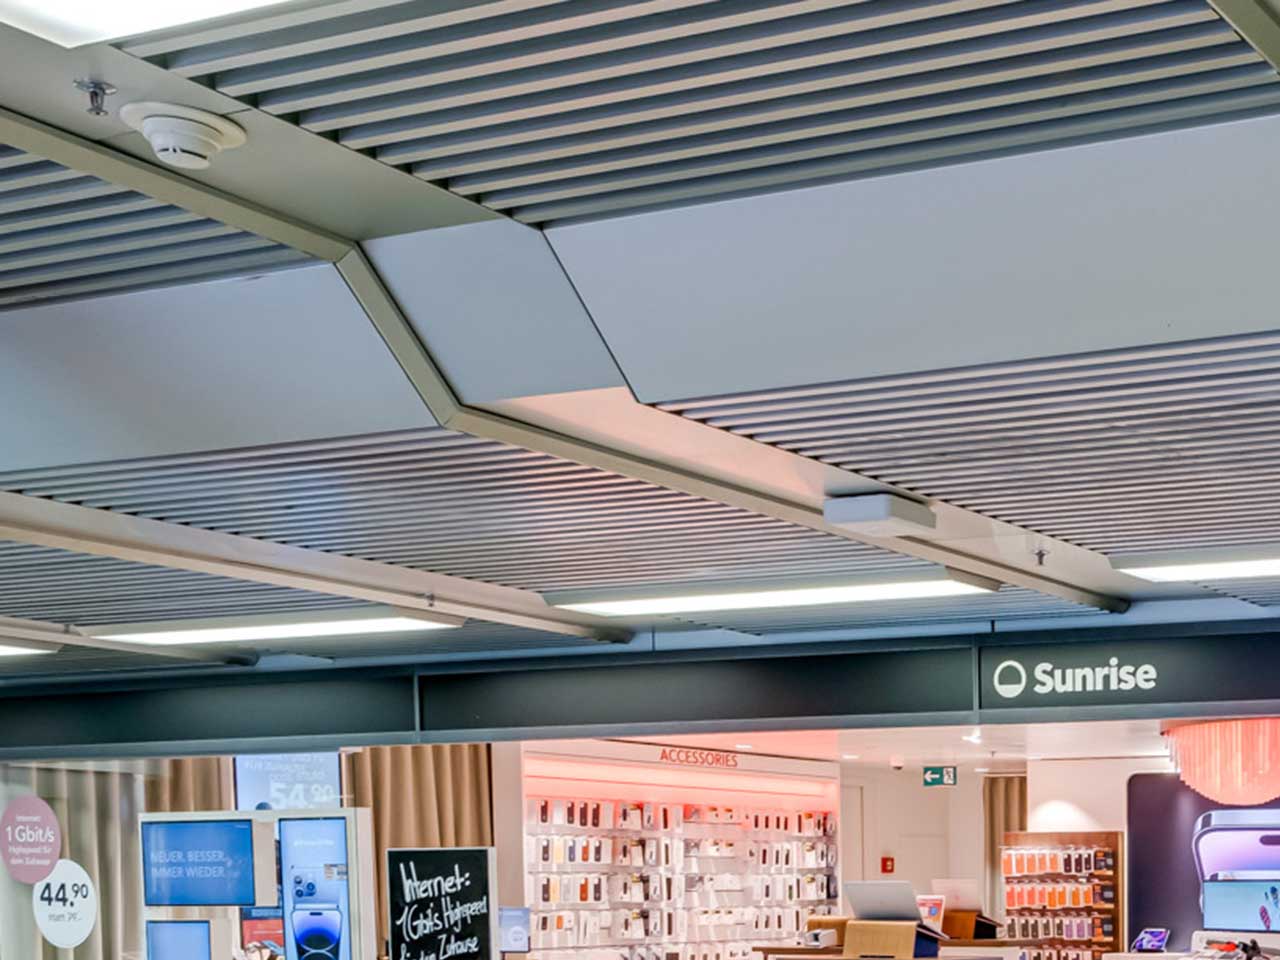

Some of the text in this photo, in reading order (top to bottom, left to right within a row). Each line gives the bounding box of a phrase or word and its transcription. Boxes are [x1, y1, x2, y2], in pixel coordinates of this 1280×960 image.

[1033, 657, 1158, 694] Sunrise
[659, 748, 739, 768] ACCESSORIES
[5, 825, 55, 843] 1 Gbit/s
[39, 882, 89, 908] 44.90
[400, 861, 471, 903] Internet:
[438, 933, 480, 960] Zuhause
